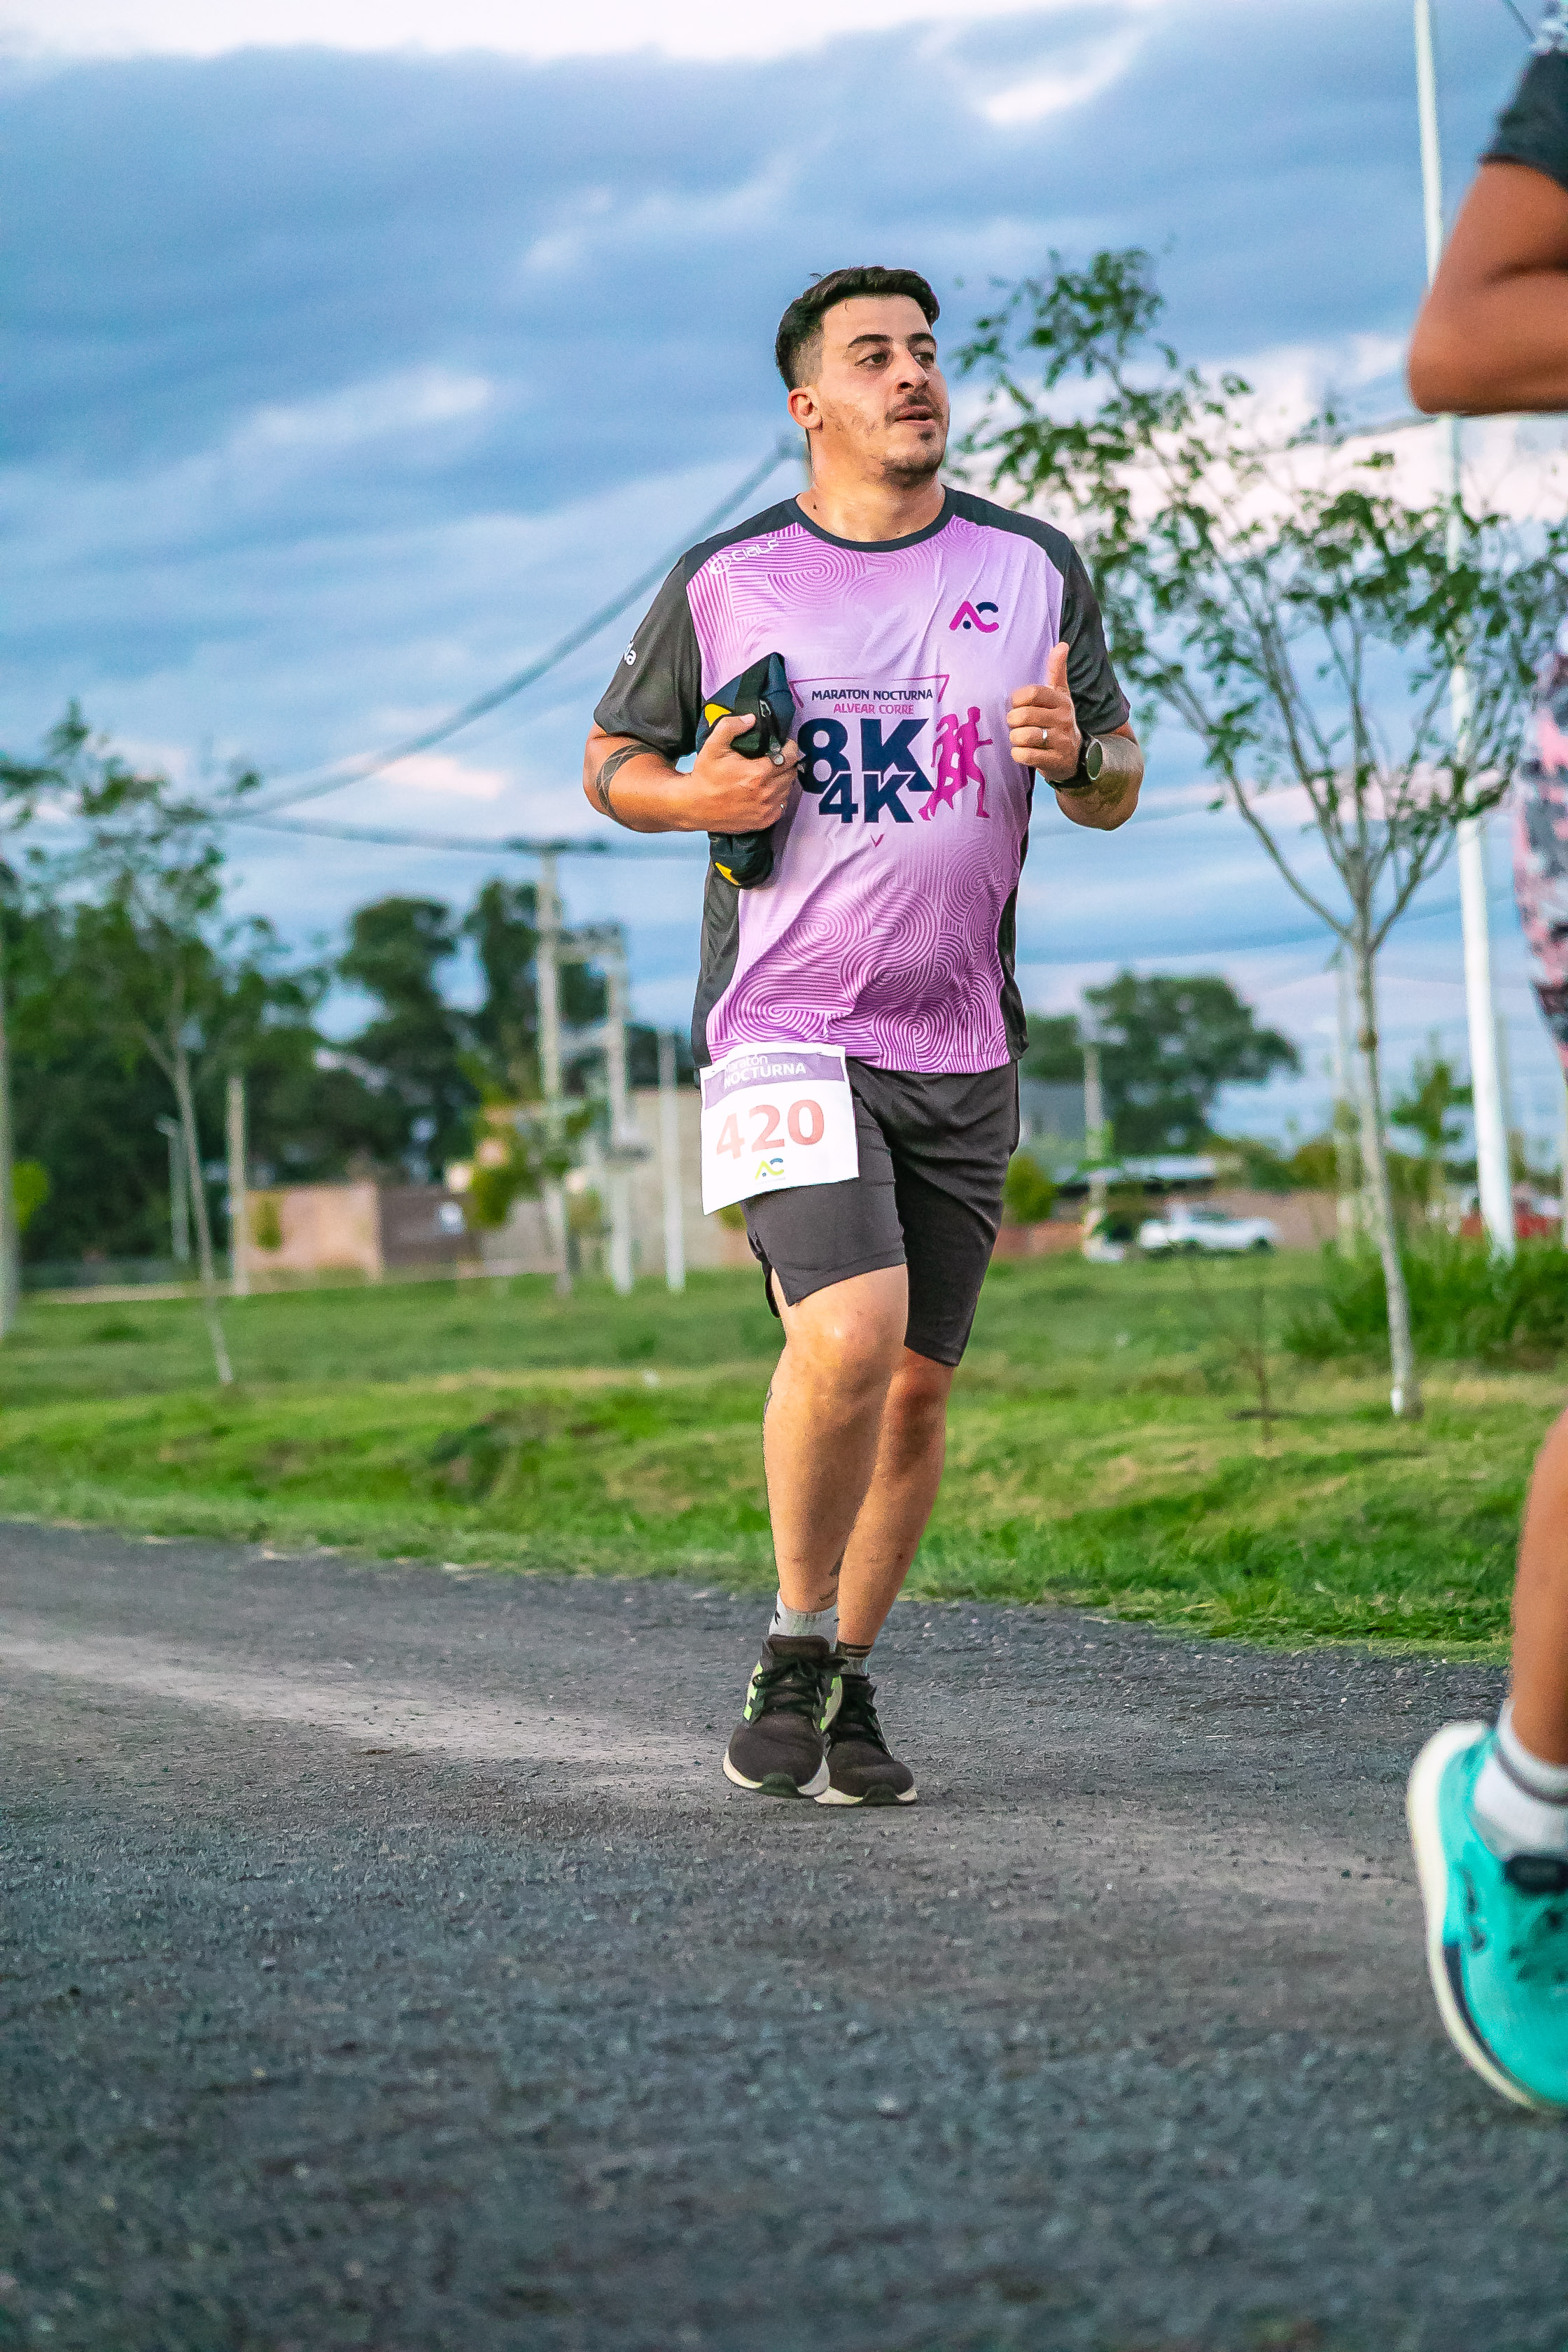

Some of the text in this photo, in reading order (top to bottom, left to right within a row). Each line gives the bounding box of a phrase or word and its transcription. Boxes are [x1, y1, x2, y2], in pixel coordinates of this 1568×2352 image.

[811, 689, 934, 701] MARATON NOCTURNA
[833, 703, 915, 715] ALVEAR CORRE
[797, 718, 935, 795] 8K
[818, 773, 915, 824] 4K
[724, 1063, 807, 1089] NOCTURNA
[716, 1099, 825, 1160] 420
